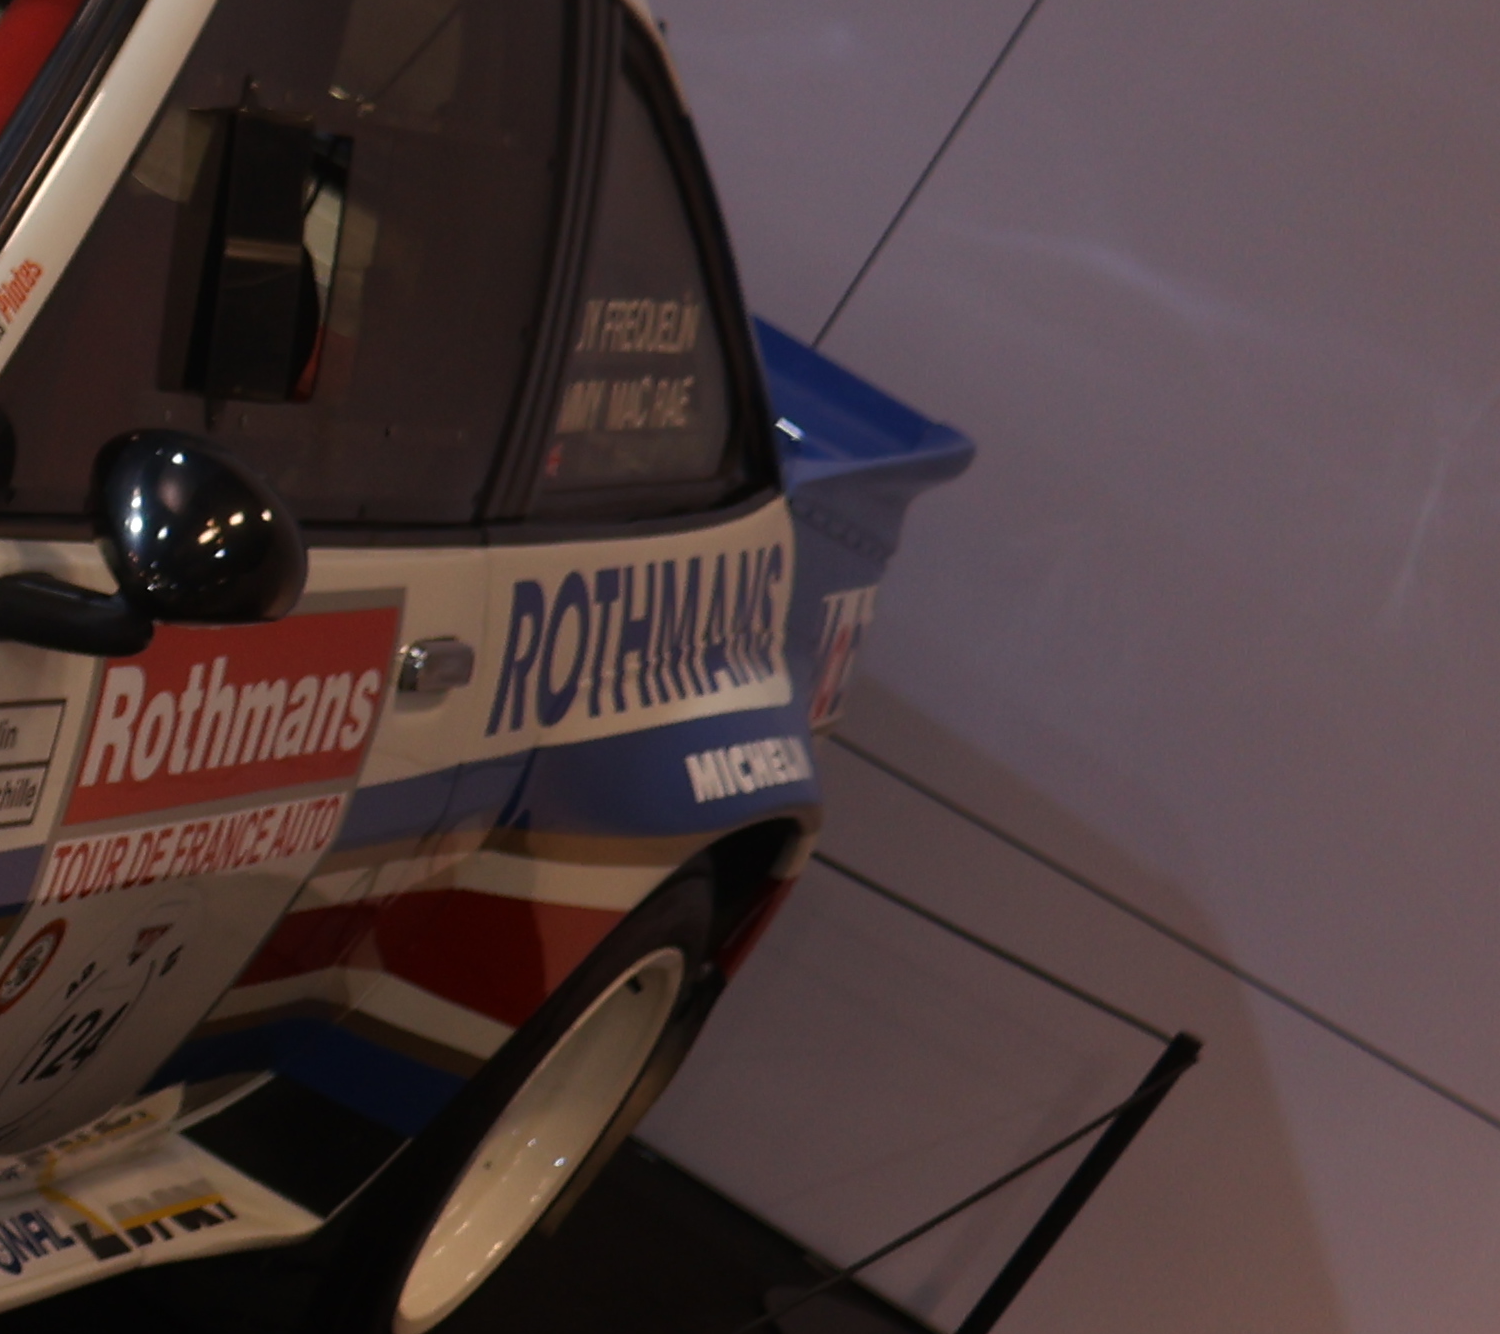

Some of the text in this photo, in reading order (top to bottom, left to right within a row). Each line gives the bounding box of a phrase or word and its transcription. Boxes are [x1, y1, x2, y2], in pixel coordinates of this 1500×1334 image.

[485, 541, 787, 737] ROTHMANS
[80, 655, 383, 788] Rothmans
[41, 795, 341, 905] TOUR DE FRANCE AUTO
